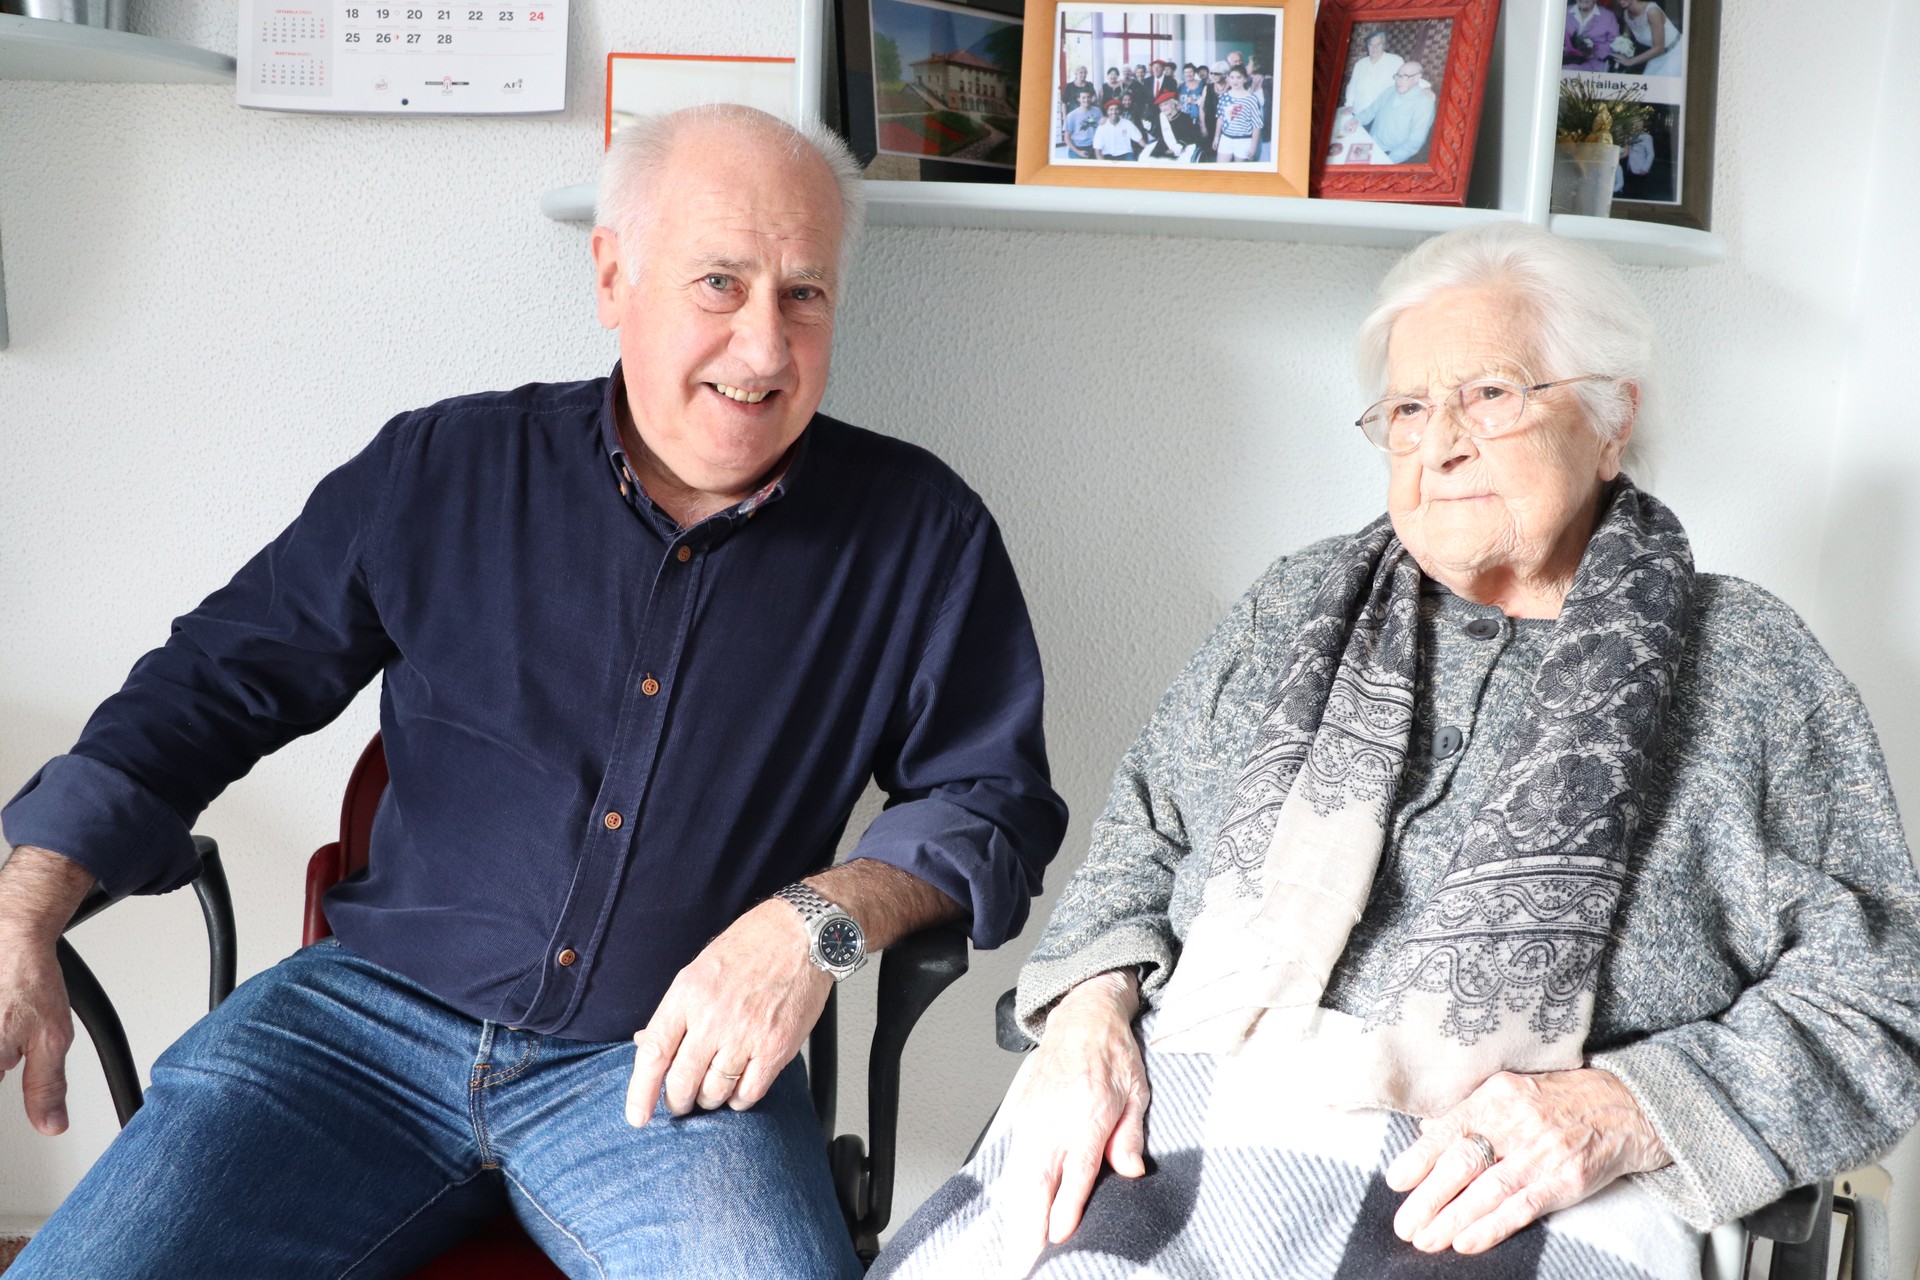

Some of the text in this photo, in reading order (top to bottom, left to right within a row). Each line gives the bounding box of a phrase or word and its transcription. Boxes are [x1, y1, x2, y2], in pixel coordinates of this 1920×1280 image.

[345, 9, 545, 22] 18 19 20 21 22 23 24
[345, 33, 453, 45] 25 26 27 28
[1632, 82, 1649, 92] 24
